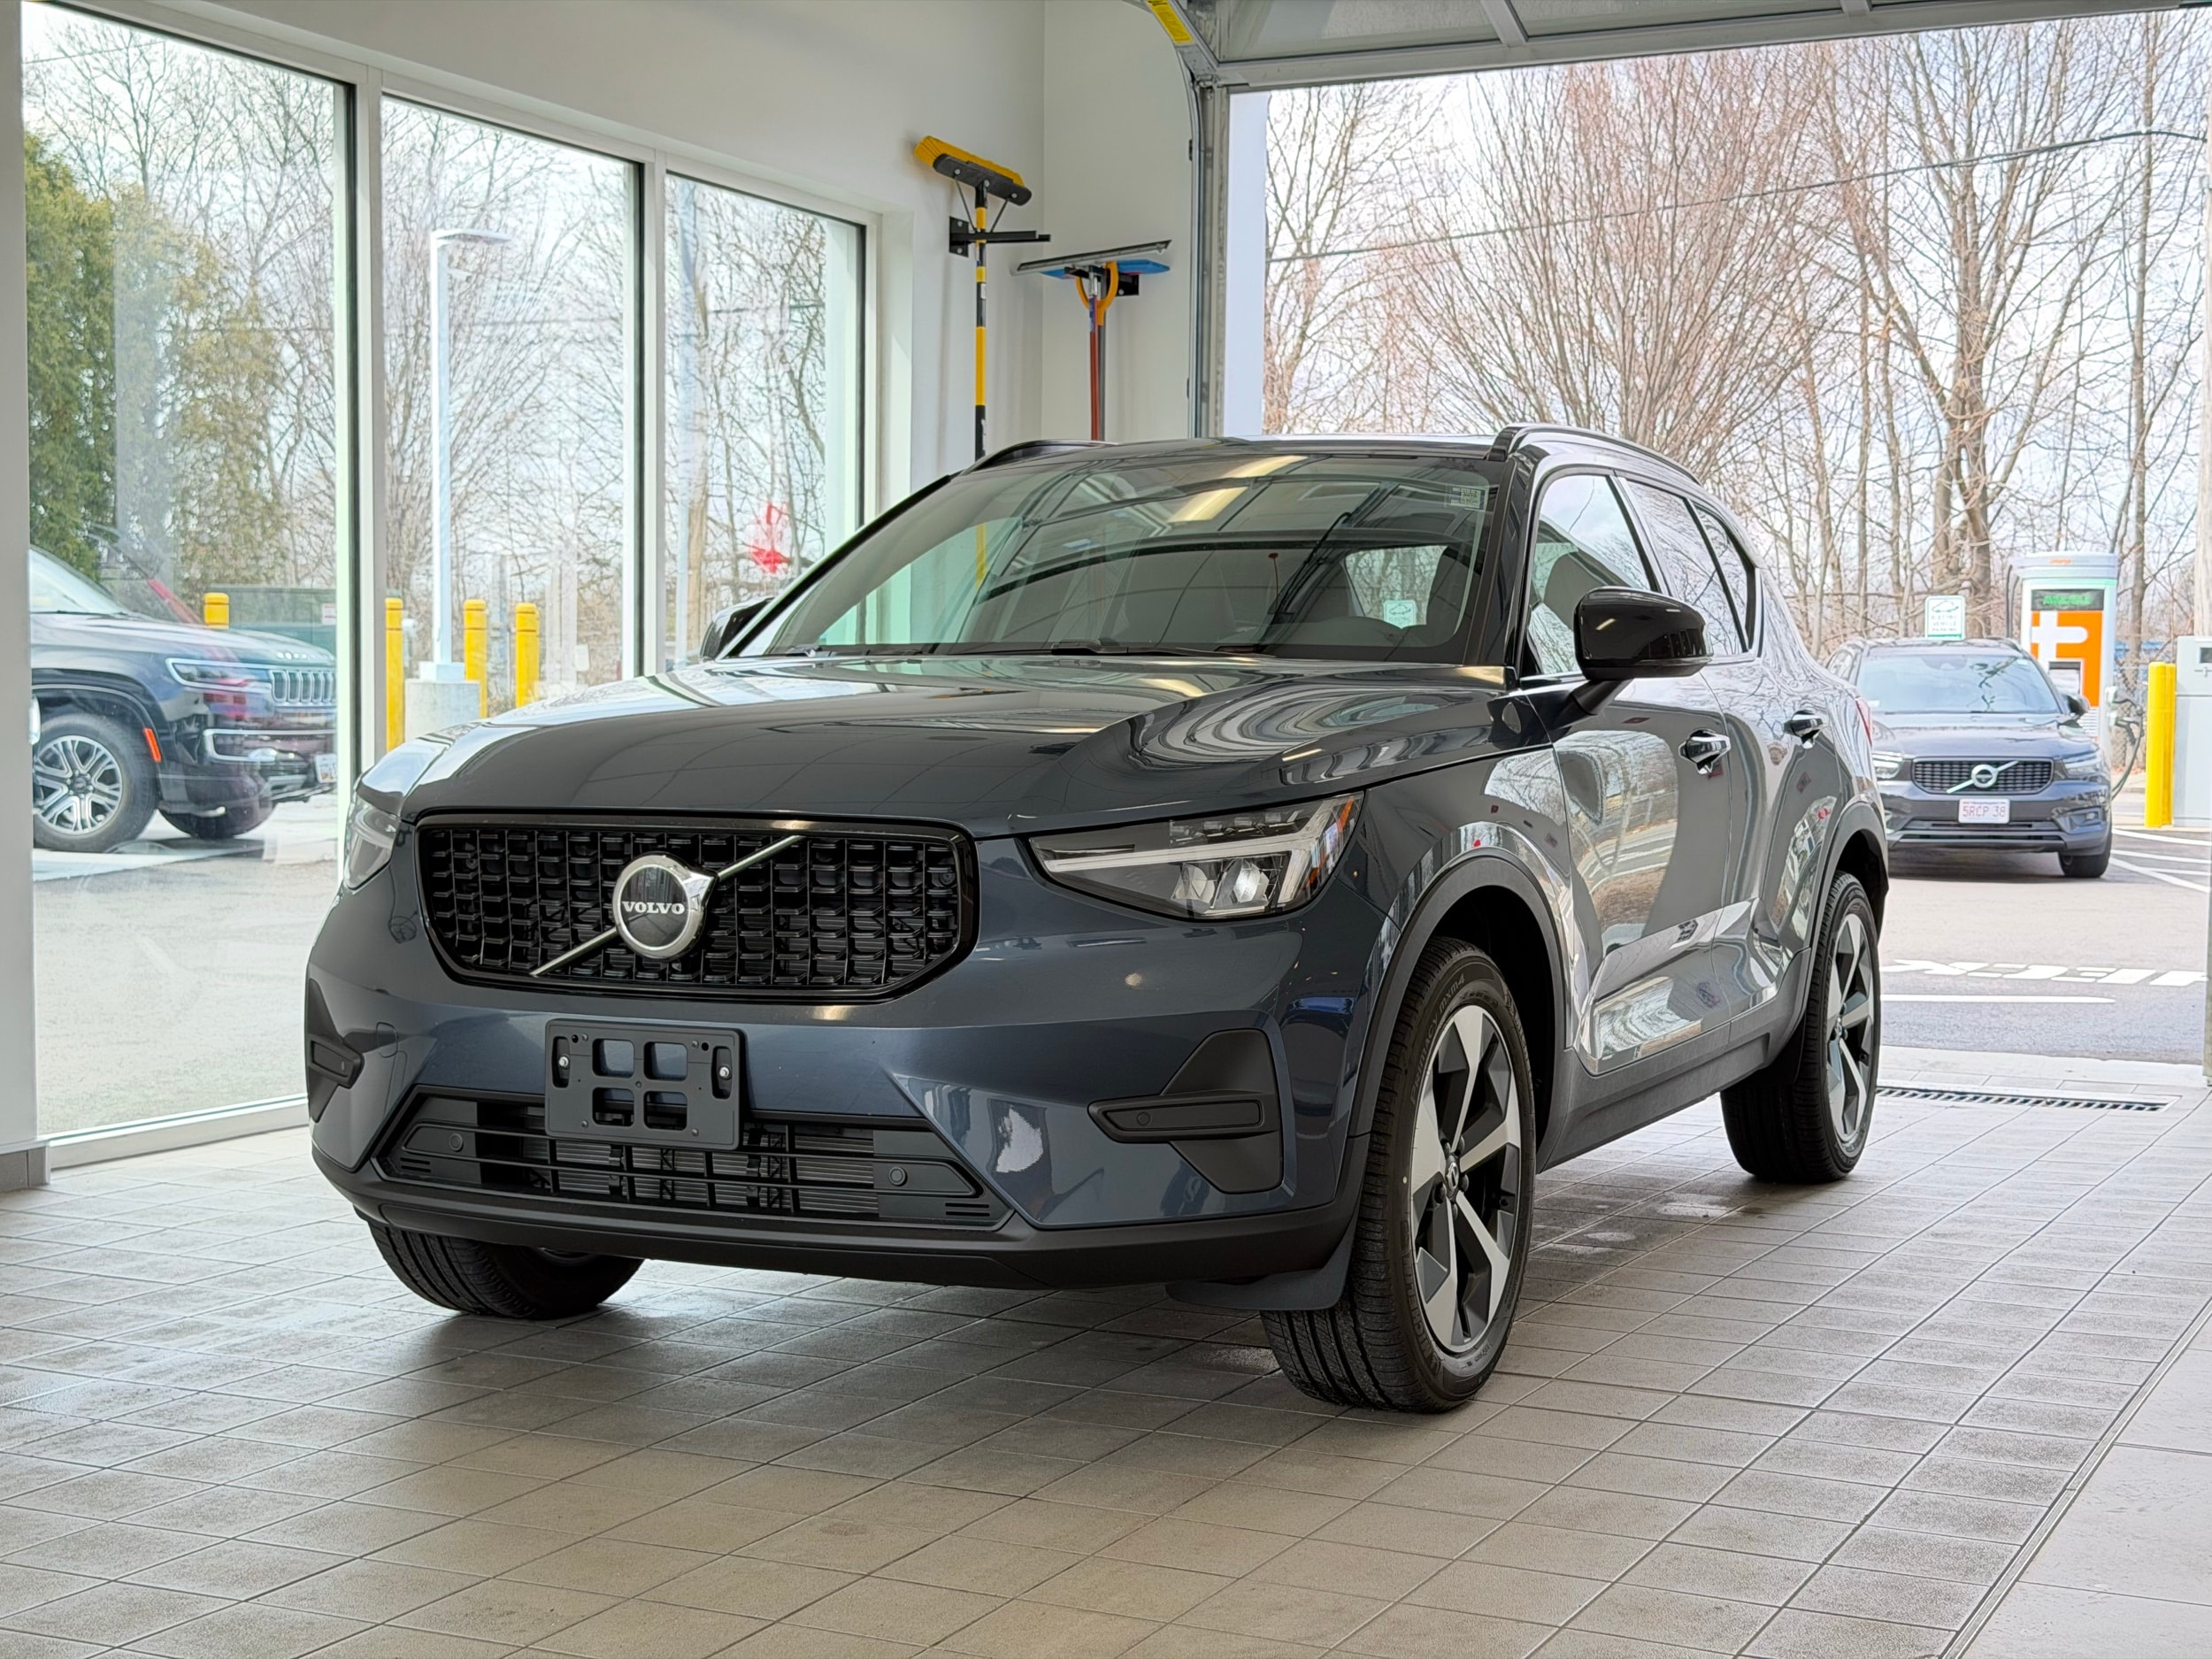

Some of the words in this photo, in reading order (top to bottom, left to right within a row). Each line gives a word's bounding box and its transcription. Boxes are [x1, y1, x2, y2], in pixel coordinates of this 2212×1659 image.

[1962, 805, 1990, 818] 5RCP
[1993, 805, 2006, 818] 38
[621, 901, 686, 916] VOLVO
[1402, 1255, 1440, 1359] MICHELIN
